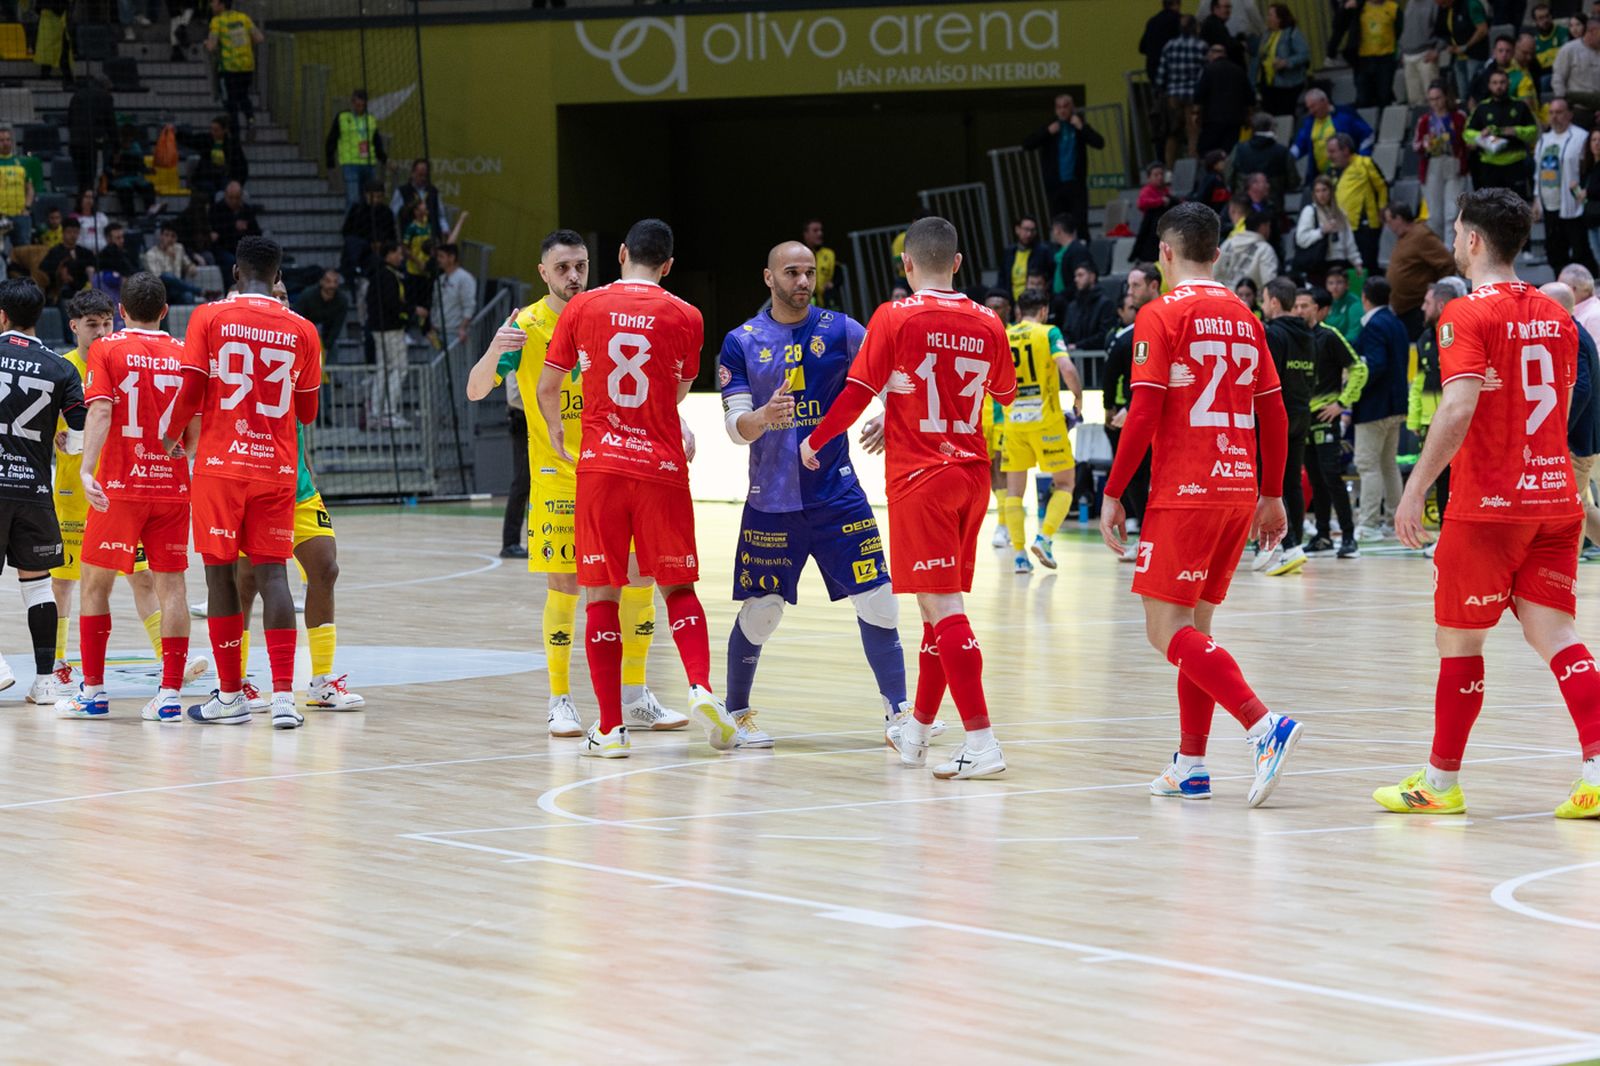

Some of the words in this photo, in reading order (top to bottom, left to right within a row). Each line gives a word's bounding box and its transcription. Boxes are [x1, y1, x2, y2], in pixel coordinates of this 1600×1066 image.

[703, 12, 847, 64] olivo
[870, 9, 1059, 56] arena
[836, 63, 881, 90] JAÉN
[885, 60, 967, 84] PARAÍSO
[972, 61, 1062, 81] INTERIOR
[609, 312, 656, 330] TOMAZ
[1194, 316, 1232, 336] DARÍO
[1237, 320, 1256, 340] GIL
[220, 323, 298, 348] MOUHOUDINE
[927, 332, 984, 354] MELLADO
[784, 344, 803, 363] 28
[0, 356, 42, 374] HISPI
[126, 354, 181, 372] CASTEJÓN
[607, 332, 652, 409] 8
[218, 341, 296, 419] 93
[1521, 343, 1558, 435] 9
[915, 352, 991, 434] 13
[118, 370, 184, 440] 17
[228, 440, 249, 455] AZ
[601, 432, 623, 447] AZ
[143, 452, 170, 462] ribera
[7, 471, 35, 479] Empleo
[8, 463, 34, 473] Aztiva
[1210, 460, 1234, 477] AZ
[1177, 482, 1208, 496] Jimbee
[1515, 472, 1540, 490] AZ
[209, 526, 236, 540] APLI
[98, 541, 134, 554] APLI
[858, 563, 872, 576] LZ
[912, 556, 955, 571] APLI
